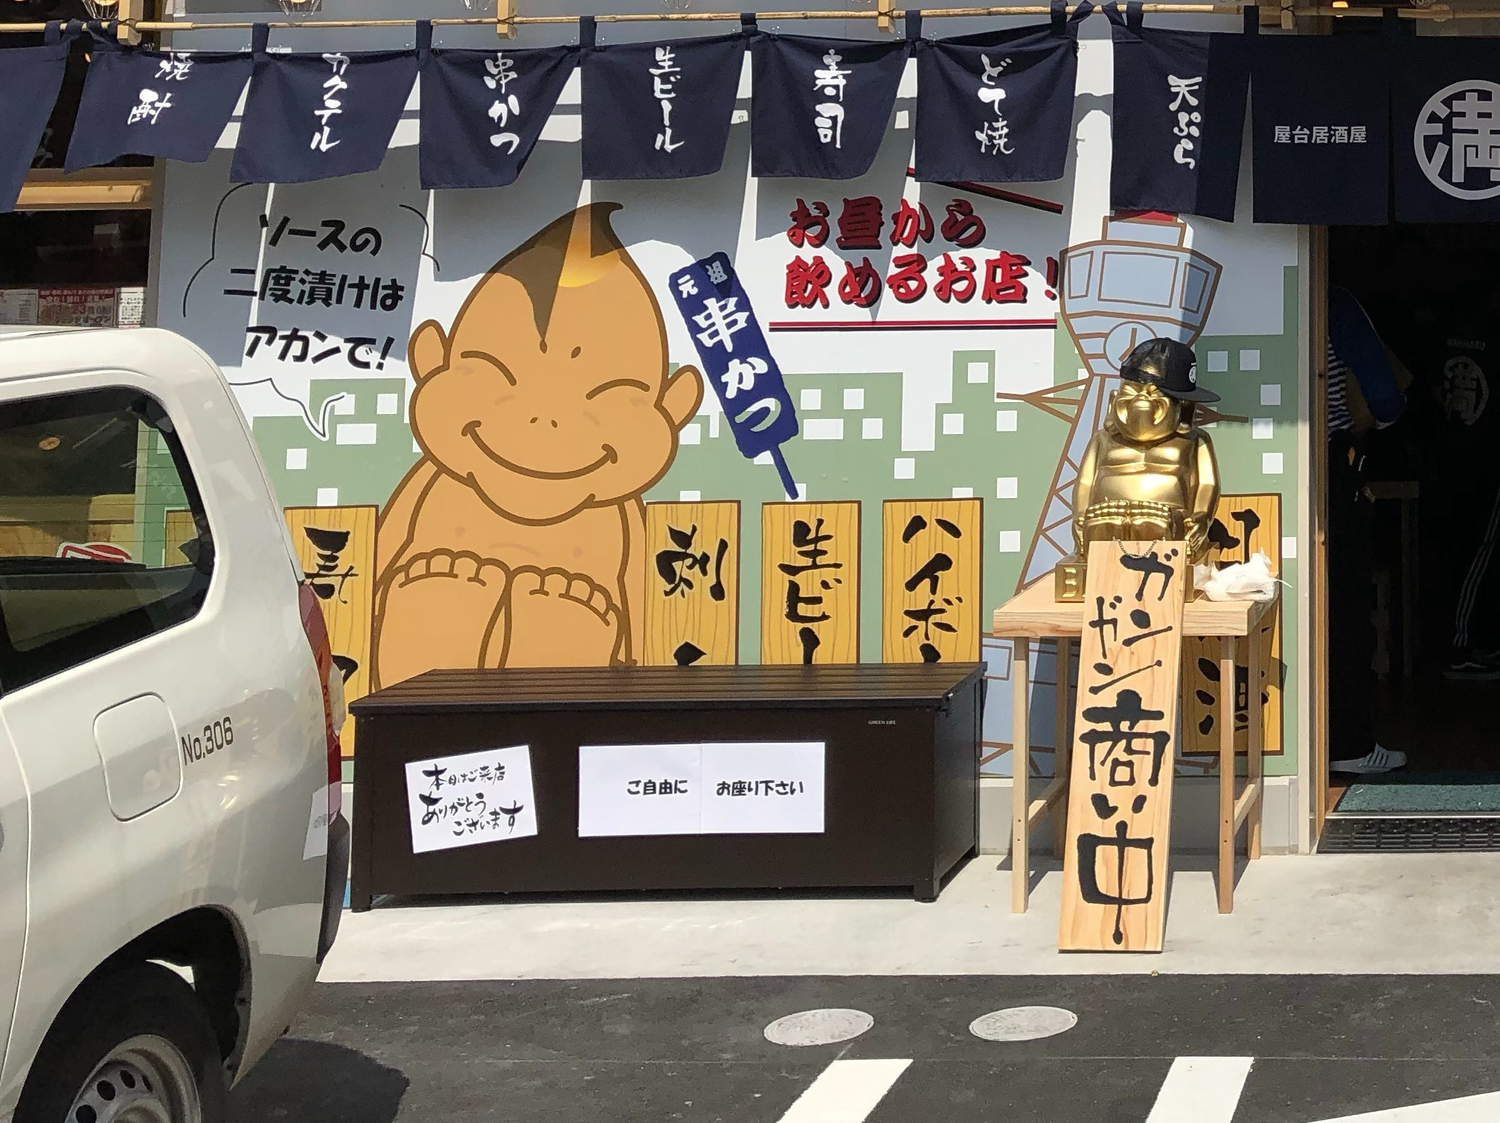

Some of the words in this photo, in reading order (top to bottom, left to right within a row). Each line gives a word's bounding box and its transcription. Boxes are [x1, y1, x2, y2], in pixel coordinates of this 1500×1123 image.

[310, 52, 351, 152] カクテル
[483, 51, 521, 155] 串かつ
[648, 45, 685, 153] 生ビール
[813, 48, 852, 149] 寿司
[975, 53, 1016, 156] どて焼
[1166, 74, 1202, 170] 天ぷら
[1273, 124, 1367, 145] 屋台居酒屋
[261, 213, 384, 257] ソースの
[785, 195, 988, 251] お昼から
[223, 265, 405, 312] 二度漬けは
[677, 260, 728, 299] 元祖
[783, 250, 1060, 310] 飲めるお店!
[245, 325, 396, 371] アカンで!
[691, 296, 783, 433] 串かつ
[655, 523, 729, 666] 刺
[181, 715, 235, 767] No.306
[419, 791, 488, 827] ありがとう
[625, 777, 689, 797] ご自由に
[714, 778, 805, 798] お座り下さい
[451, 799, 525, 837] ございます
